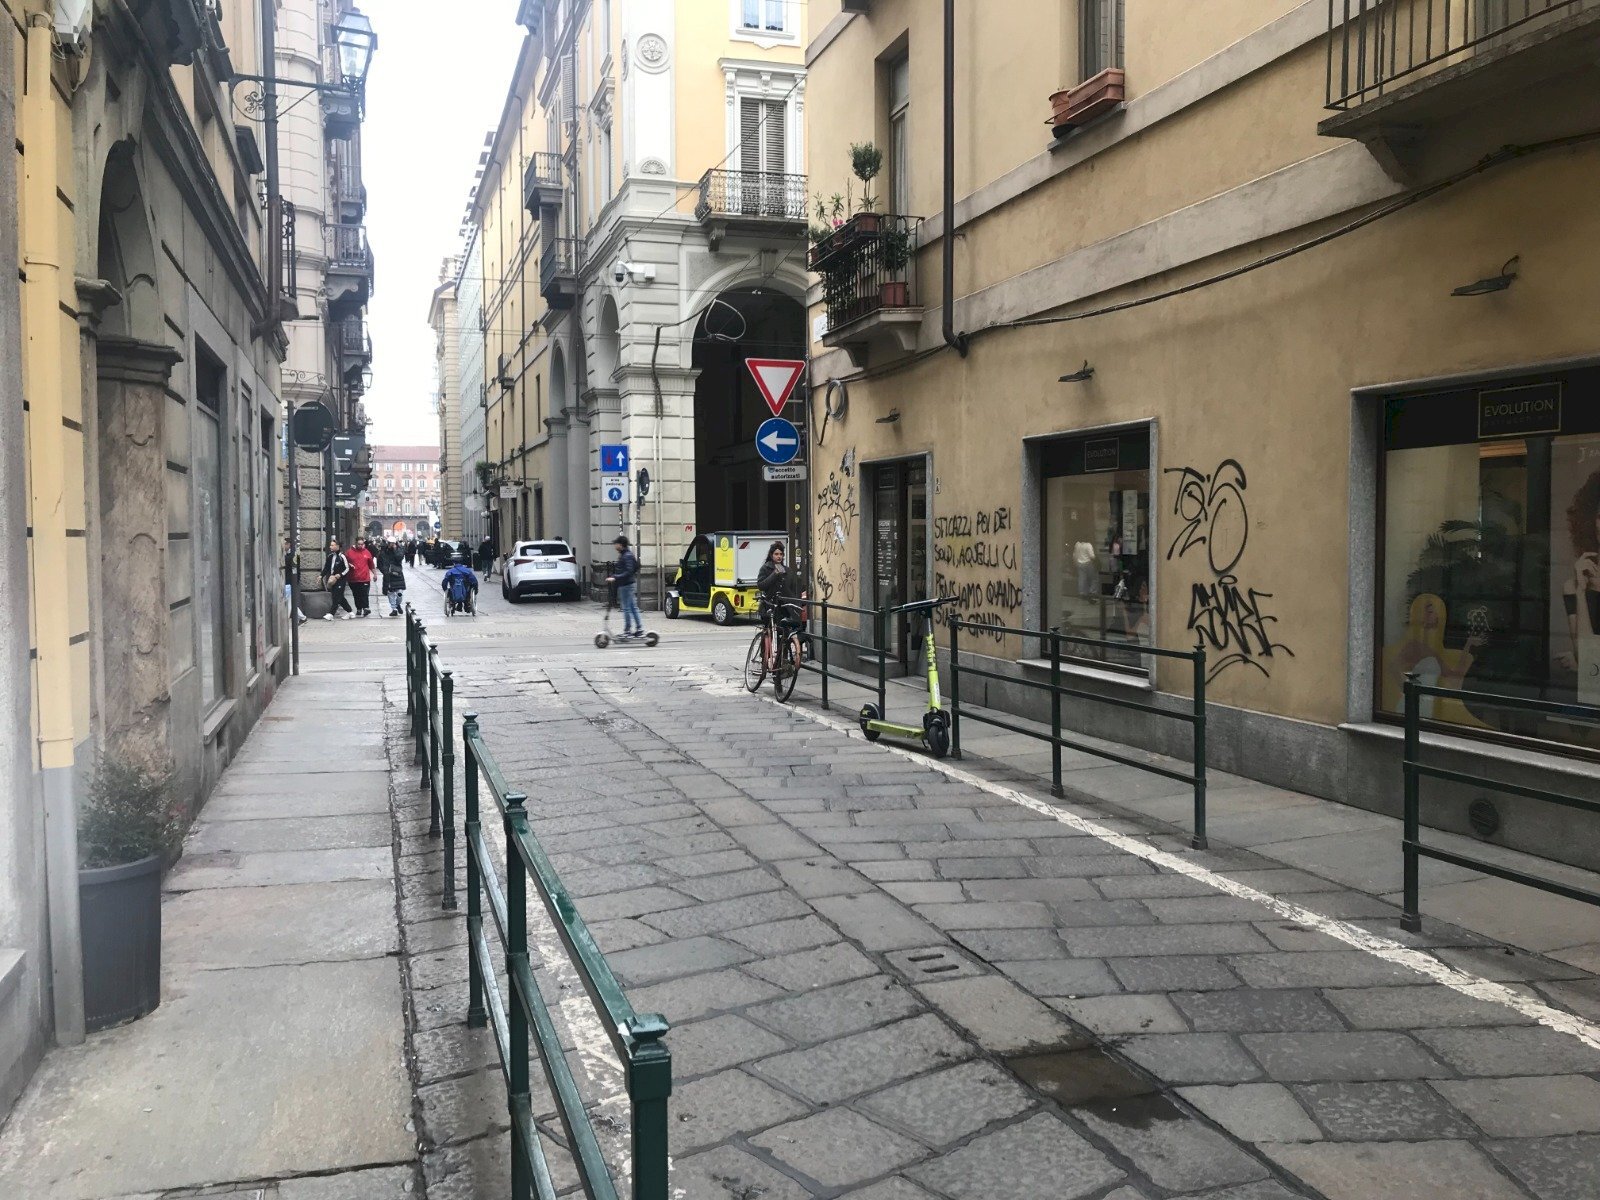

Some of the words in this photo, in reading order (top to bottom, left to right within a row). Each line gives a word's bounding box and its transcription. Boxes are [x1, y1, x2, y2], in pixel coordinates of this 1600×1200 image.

[1484, 399, 1554, 417] EVOLUTION
[934, 514, 972, 539] STICAZZI
[976, 511, 991, 536] POI
[1002, 542, 1017, 570] CI
